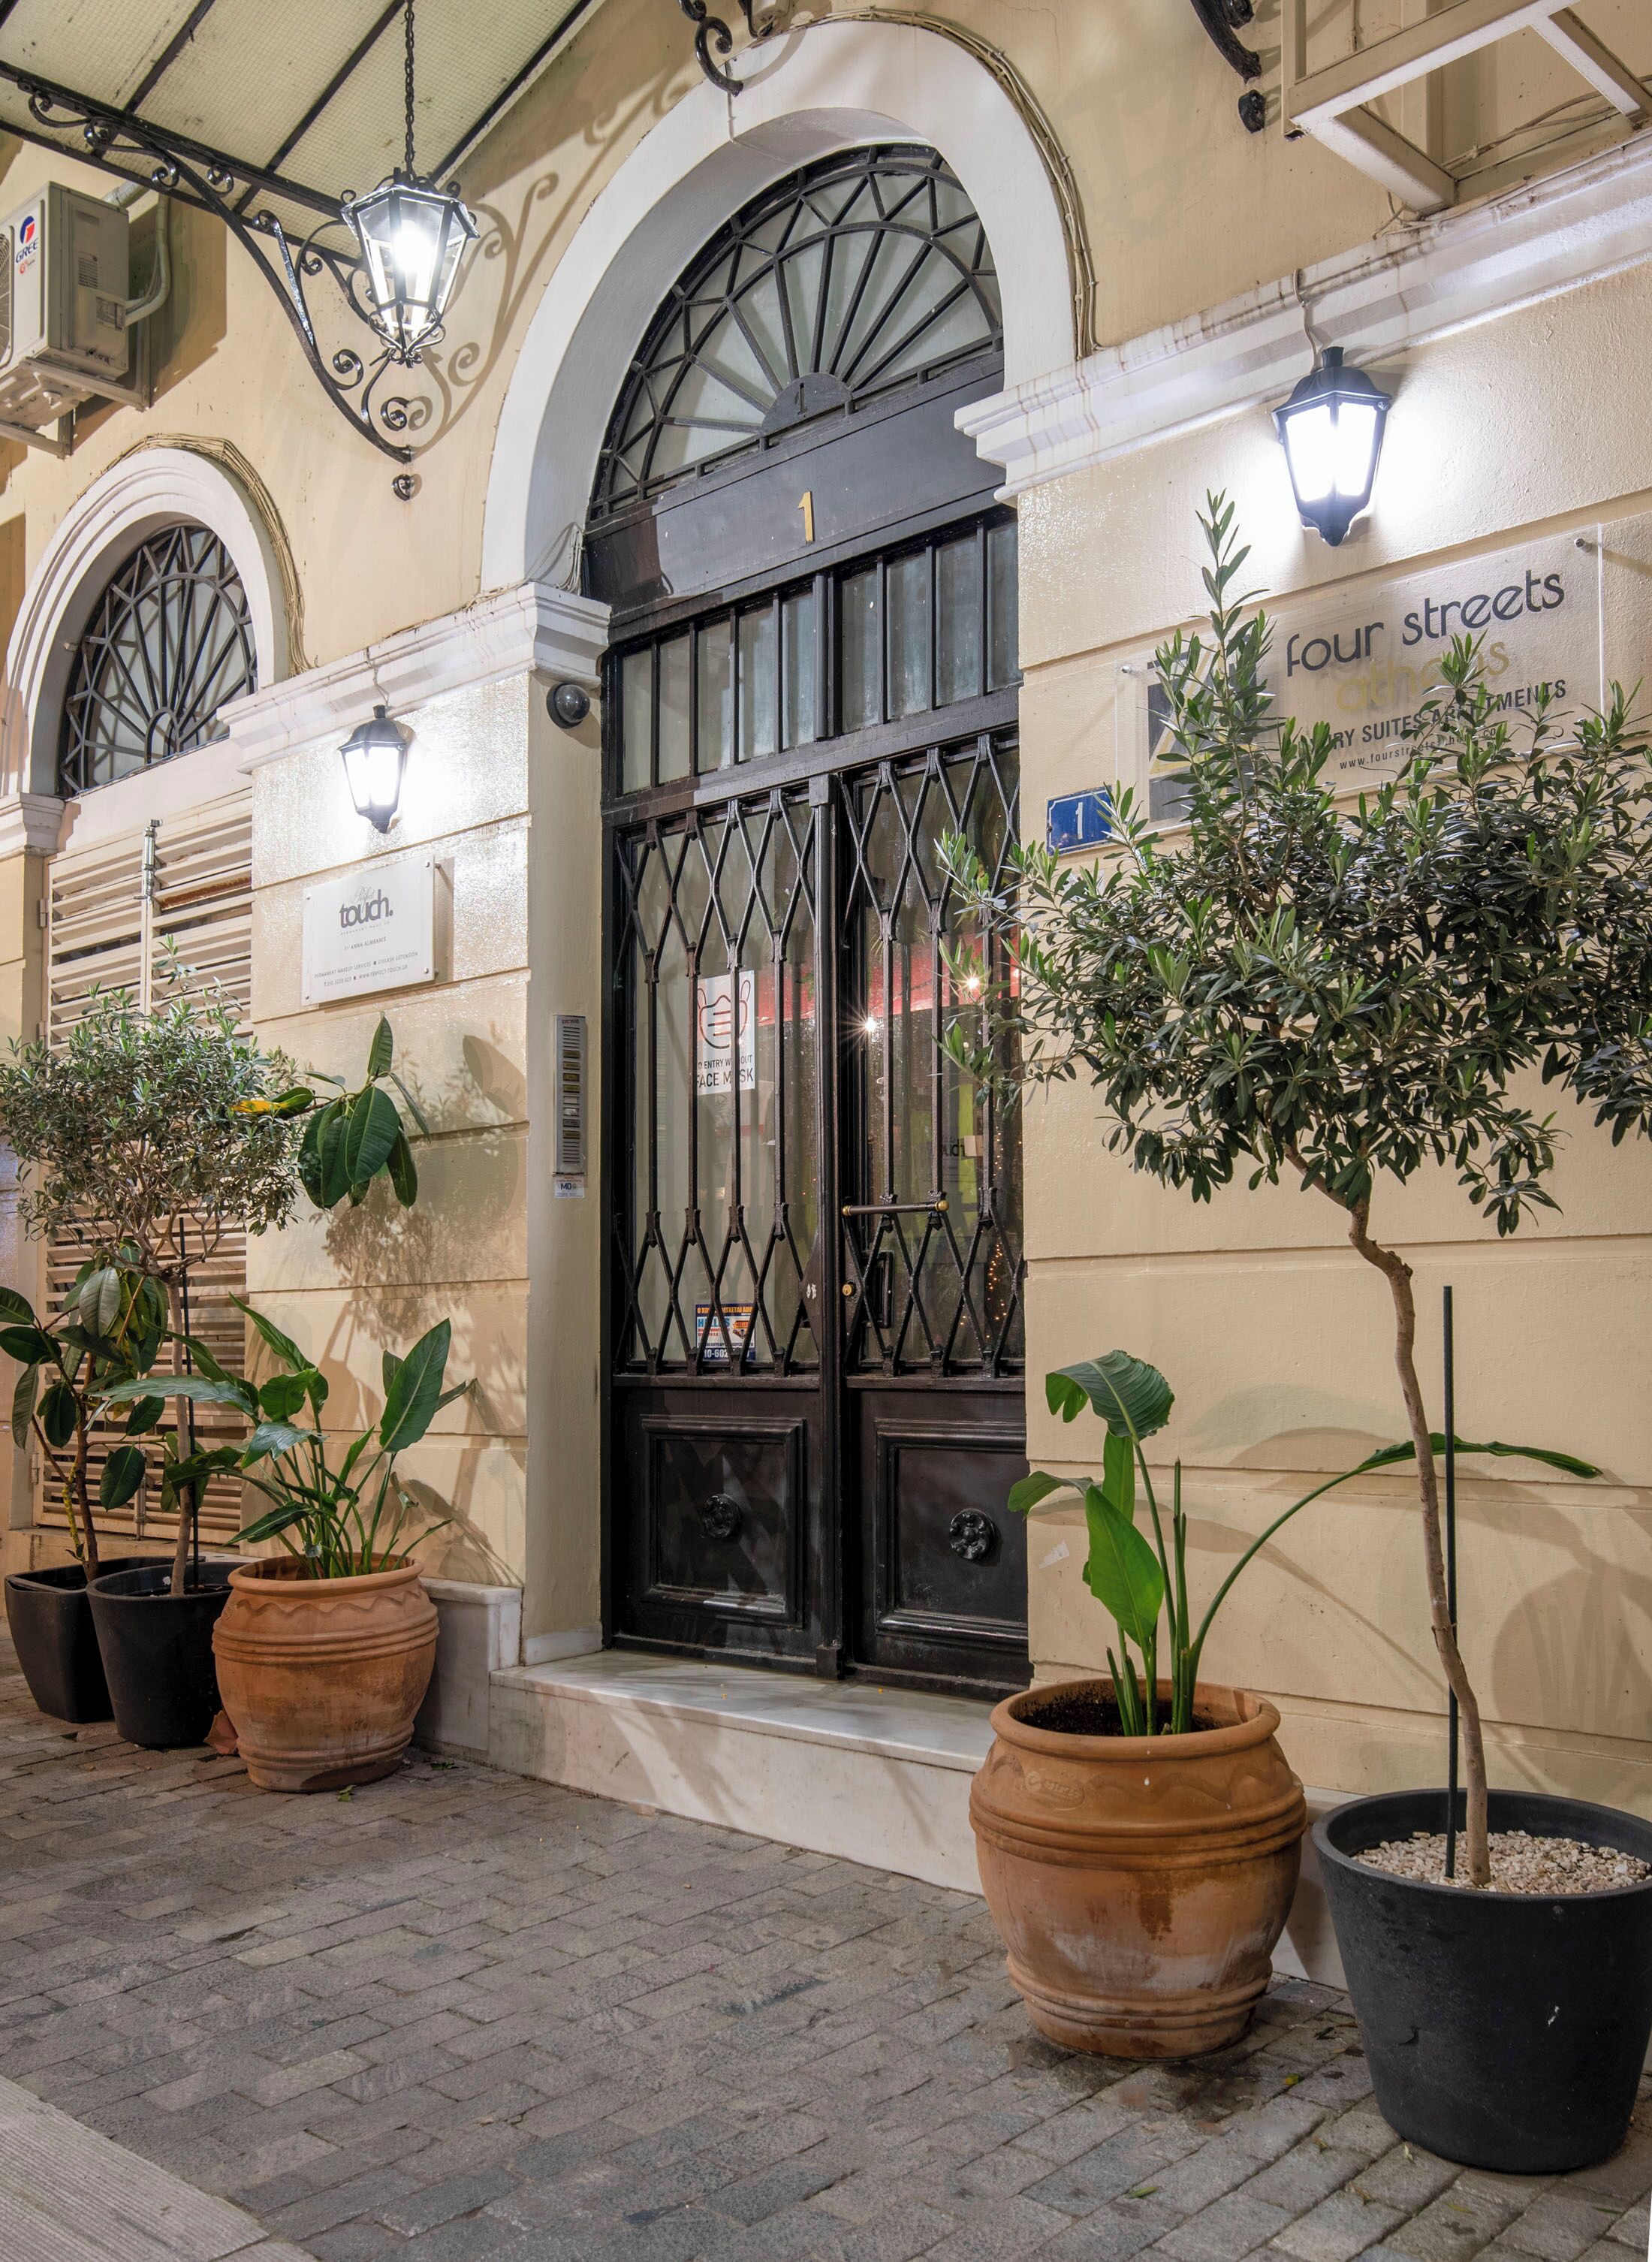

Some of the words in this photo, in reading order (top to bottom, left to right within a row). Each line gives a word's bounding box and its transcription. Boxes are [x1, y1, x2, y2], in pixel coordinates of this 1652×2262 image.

[16, 237, 38, 263] GREE
[797, 490, 814, 544] 1
[1287, 623, 1384, 677] four
[1402, 570, 1564, 646] streets
[1362, 713, 1421, 743] SUITES
[1075, 802, 1083, 840] 1
[354, 961, 372, 970] SERVICES
[704, 1058, 724, 1069] ENTRY
[725, 1054, 752, 1066] WOUT
[723, 1067, 754, 1085] MSK
